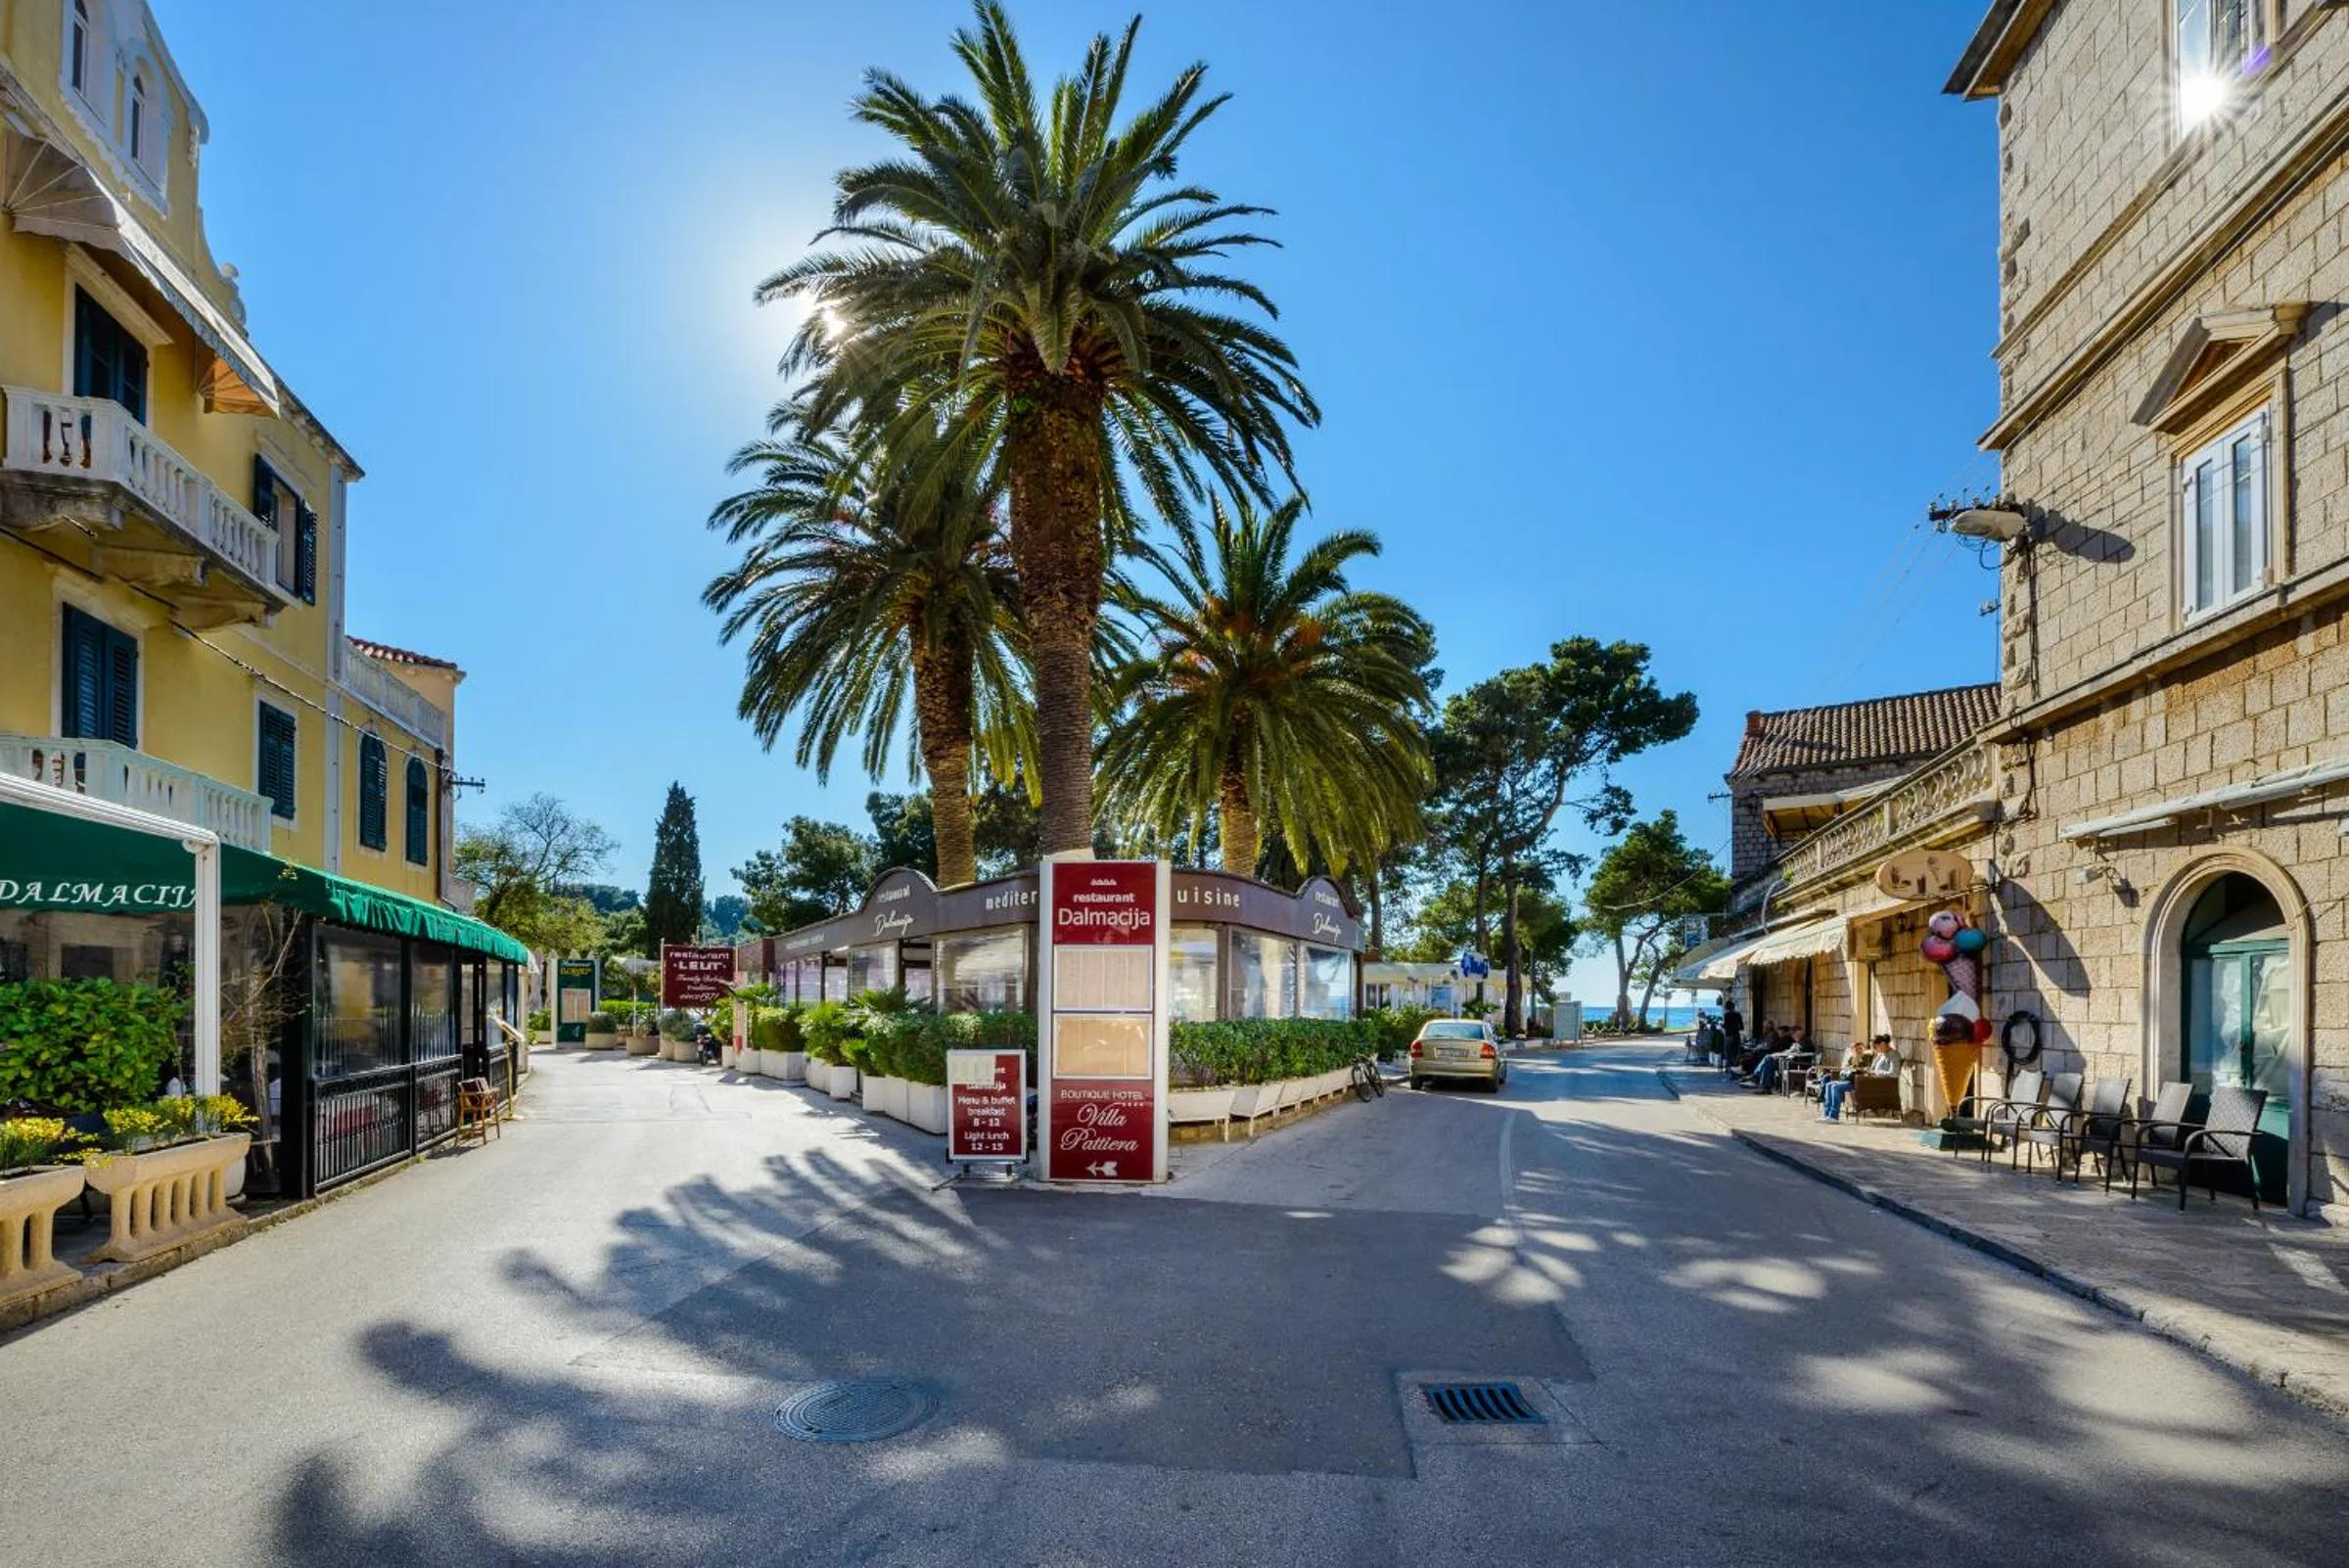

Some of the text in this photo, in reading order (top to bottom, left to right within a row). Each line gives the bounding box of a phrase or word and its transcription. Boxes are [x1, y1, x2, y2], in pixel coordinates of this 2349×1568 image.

[986, 887, 1240, 909] mediter uisine
[1073, 893, 1135, 902] restaurant
[1058, 906, 1151, 930] Dalmacija
[669, 951, 729, 960] restaurant
[1060, 1089, 1143, 1100] BOUTIQUE HOTEL
[967, 1107, 1006, 1116] breakfast
[1078, 1102, 1127, 1127] Villa
[973, 1118, 980, 1127] 8
[989, 1118, 1000, 1127] 12
[964, 1130, 985, 1141] Light
[1060, 1128, 1139, 1151] Pattiera
[971, 1142, 983, 1151] 12
[991, 1142, 1003, 1151] 15
